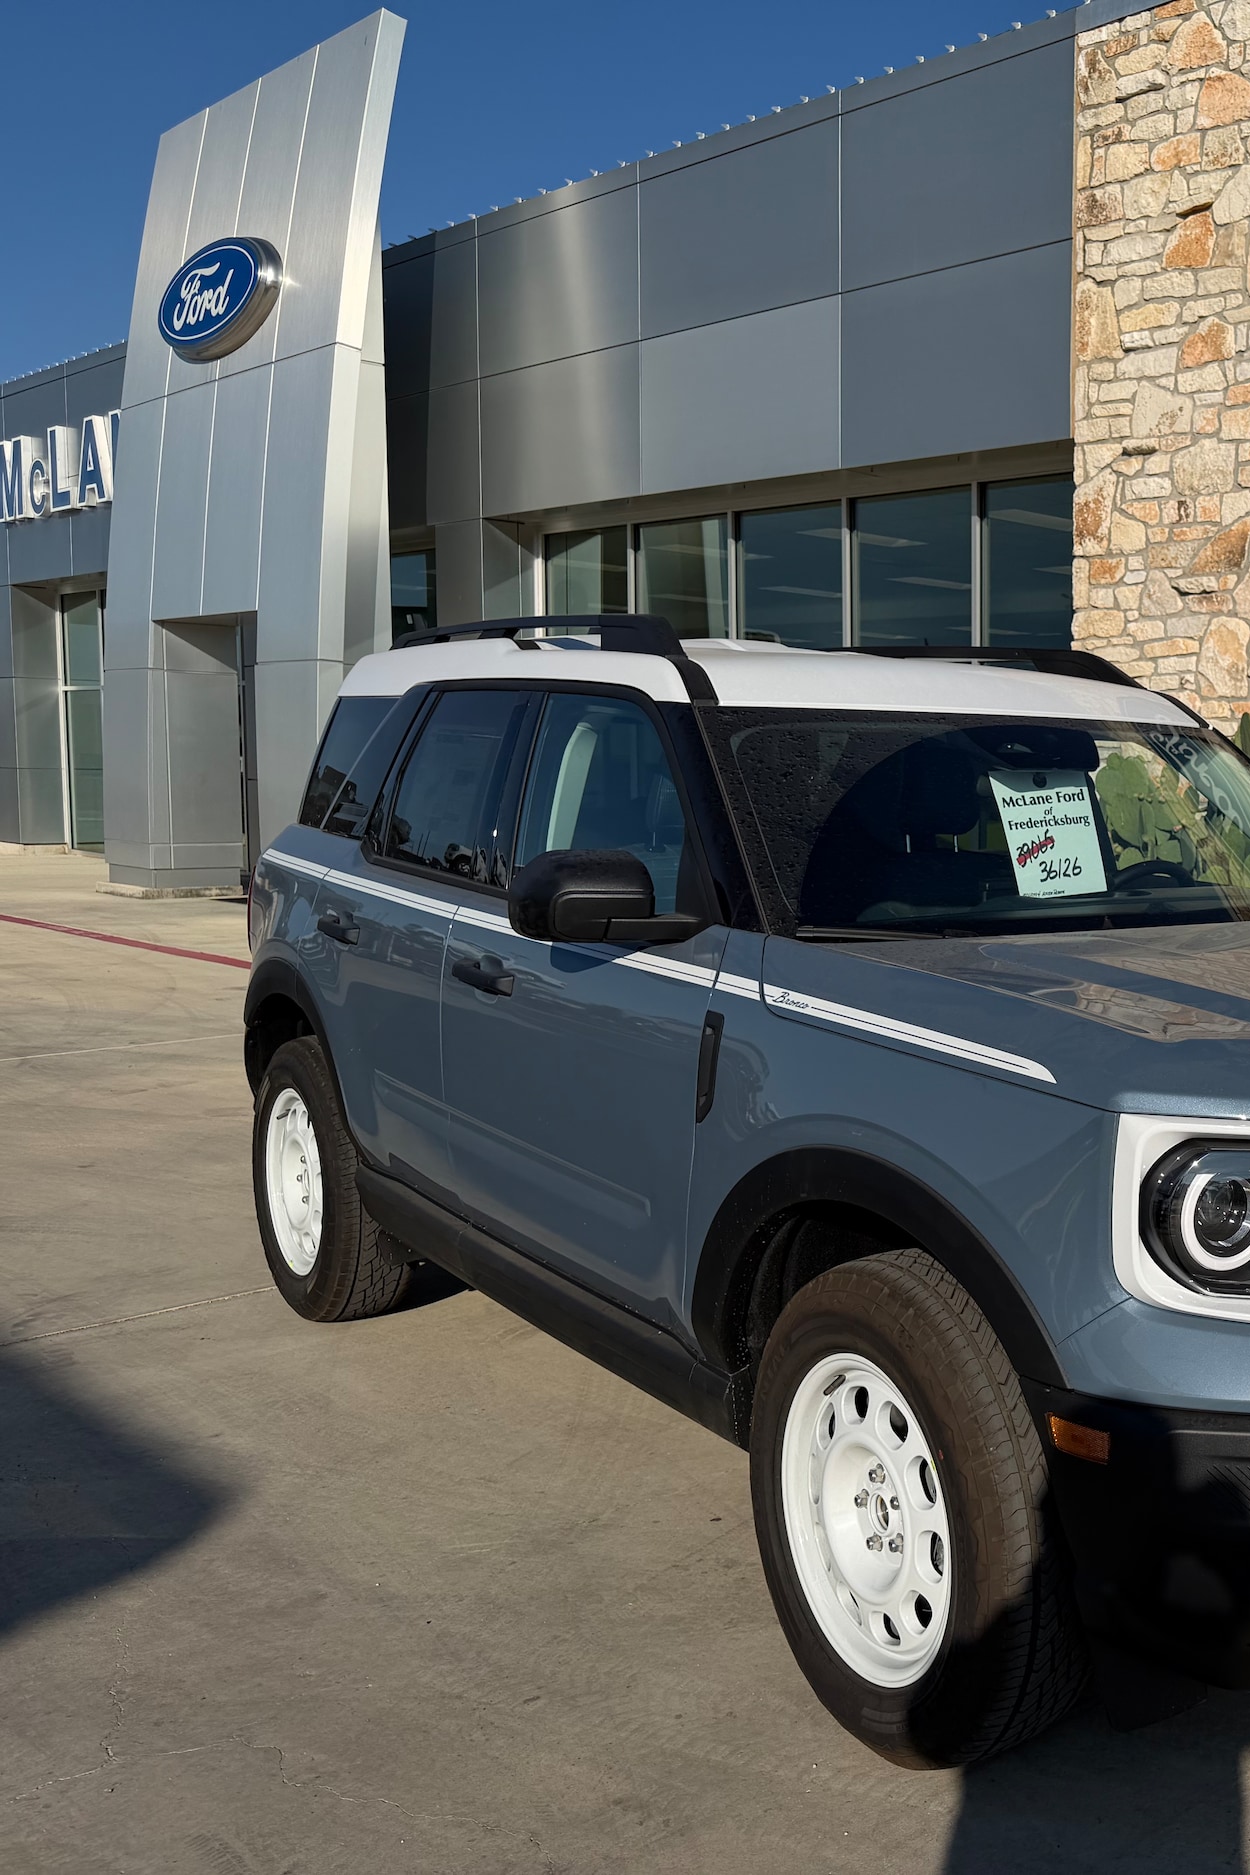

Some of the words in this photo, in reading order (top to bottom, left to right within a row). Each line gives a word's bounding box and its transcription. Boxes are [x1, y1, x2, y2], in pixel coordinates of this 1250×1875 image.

[173, 260, 235, 332] Ford
[0, 409, 122, 523] McLA
[1001, 793, 1054, 809] McLane
[1056, 788, 1086, 804] Ford
[1043, 806, 1054, 816] of
[1007, 813, 1091, 831] Fredericksburg
[772, 991, 810, 1010] Bronco
